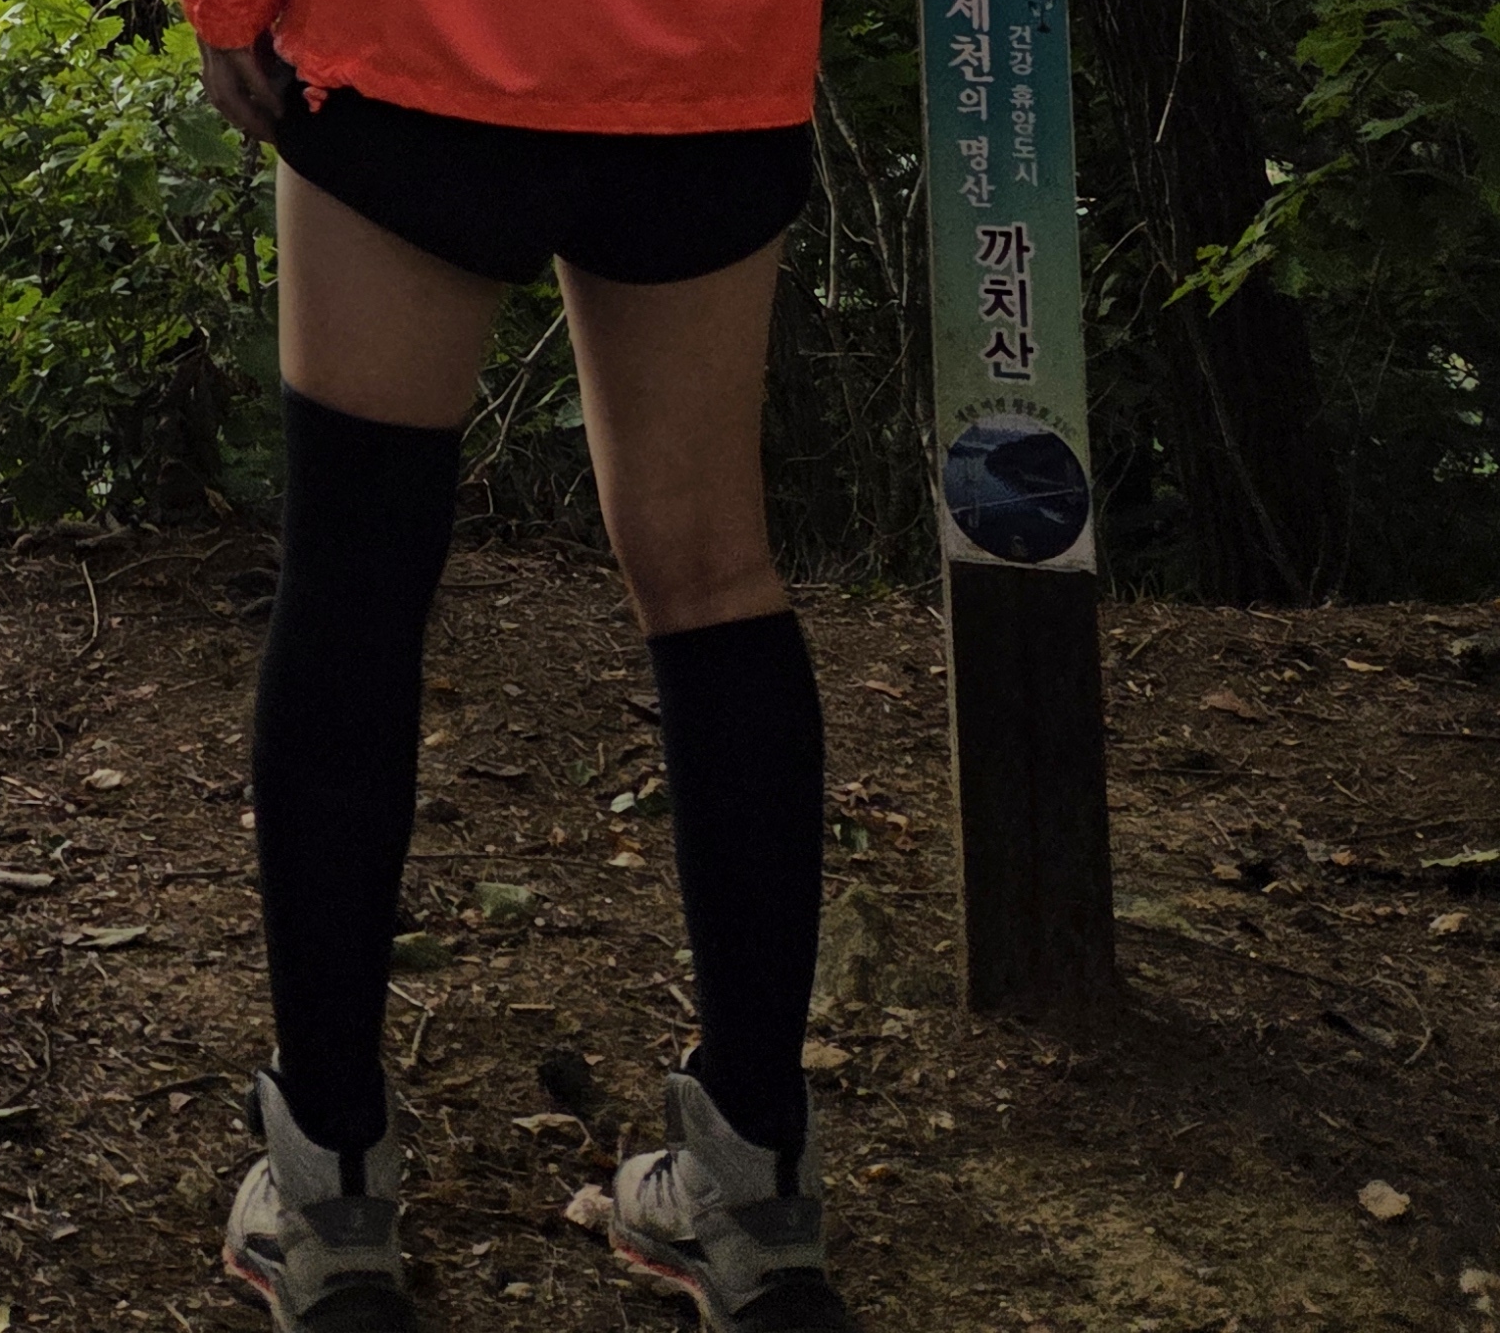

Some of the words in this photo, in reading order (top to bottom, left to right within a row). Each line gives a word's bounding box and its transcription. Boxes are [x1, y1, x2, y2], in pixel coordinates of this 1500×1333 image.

[1008, 24, 1033, 76] 건강
[957, 135, 997, 209] 명산
[975, 221, 1036, 383] 까치산
